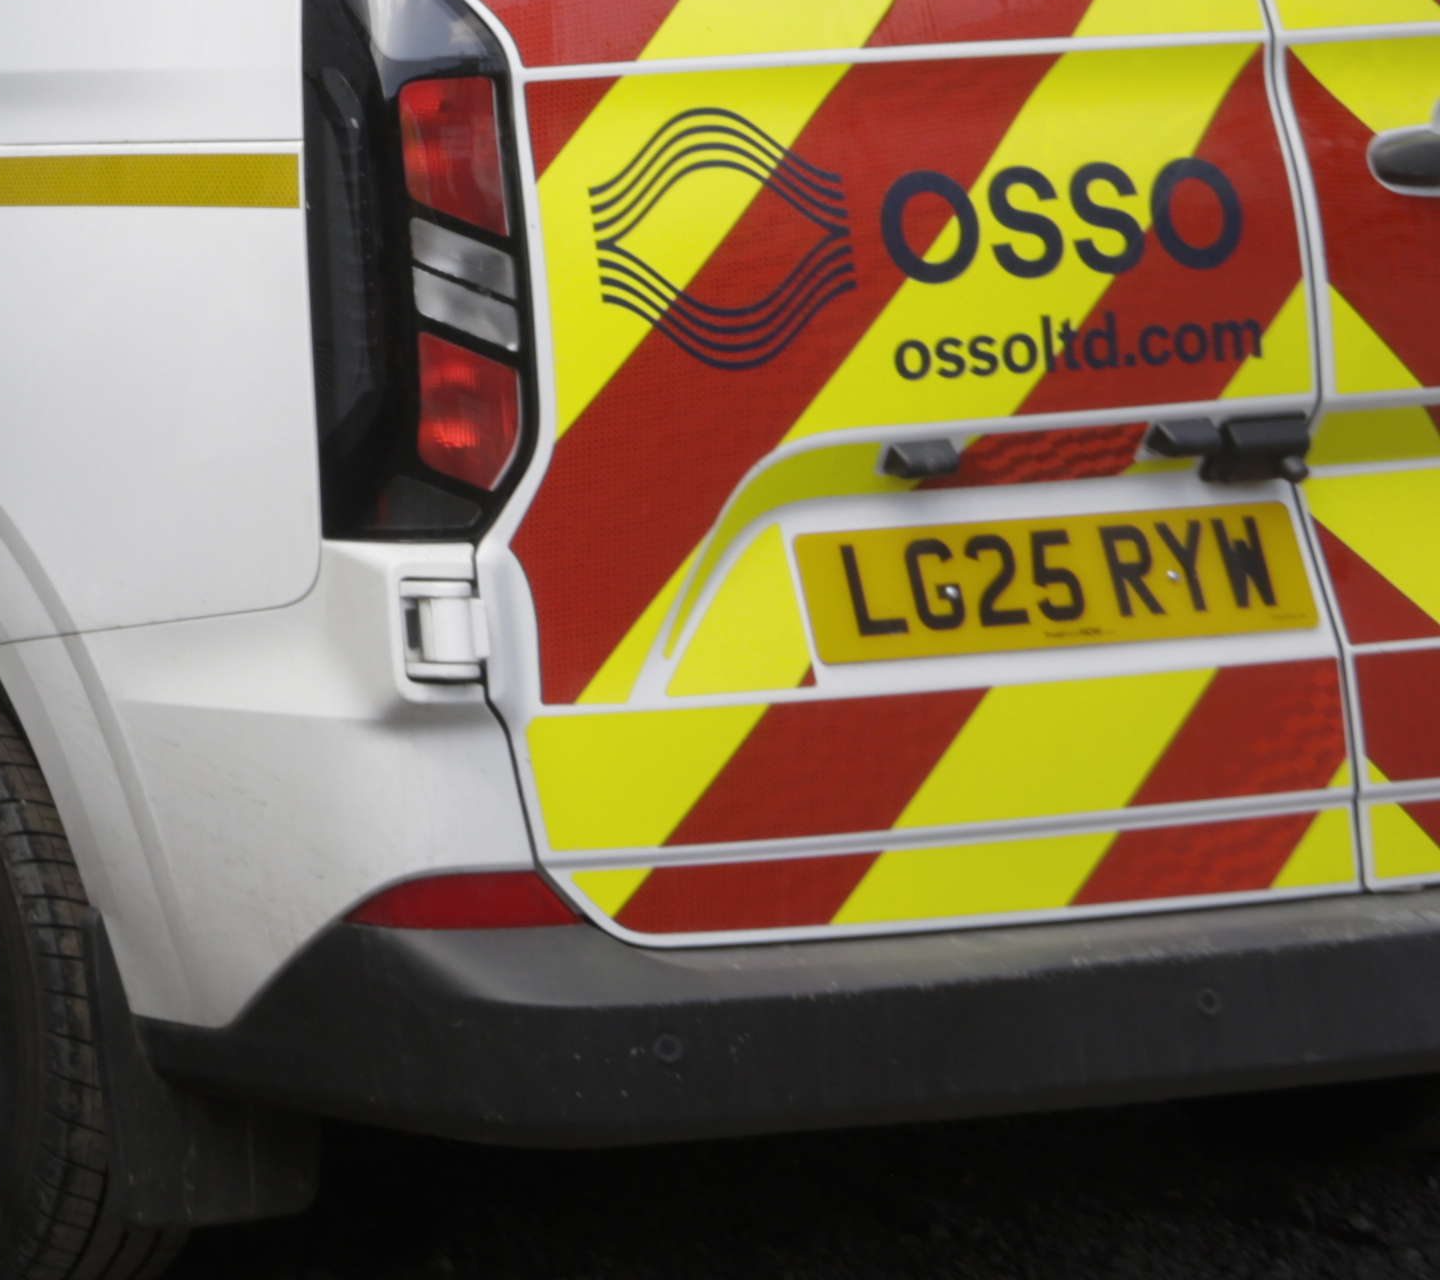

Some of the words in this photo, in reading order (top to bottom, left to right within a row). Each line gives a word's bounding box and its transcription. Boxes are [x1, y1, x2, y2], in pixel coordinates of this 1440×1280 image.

[880, 157, 1243, 284] OSSO
[894, 312, 1263, 380] ossoltd.com
[840, 529, 1086, 638] LG25
[1099, 515, 1278, 618] RYW
